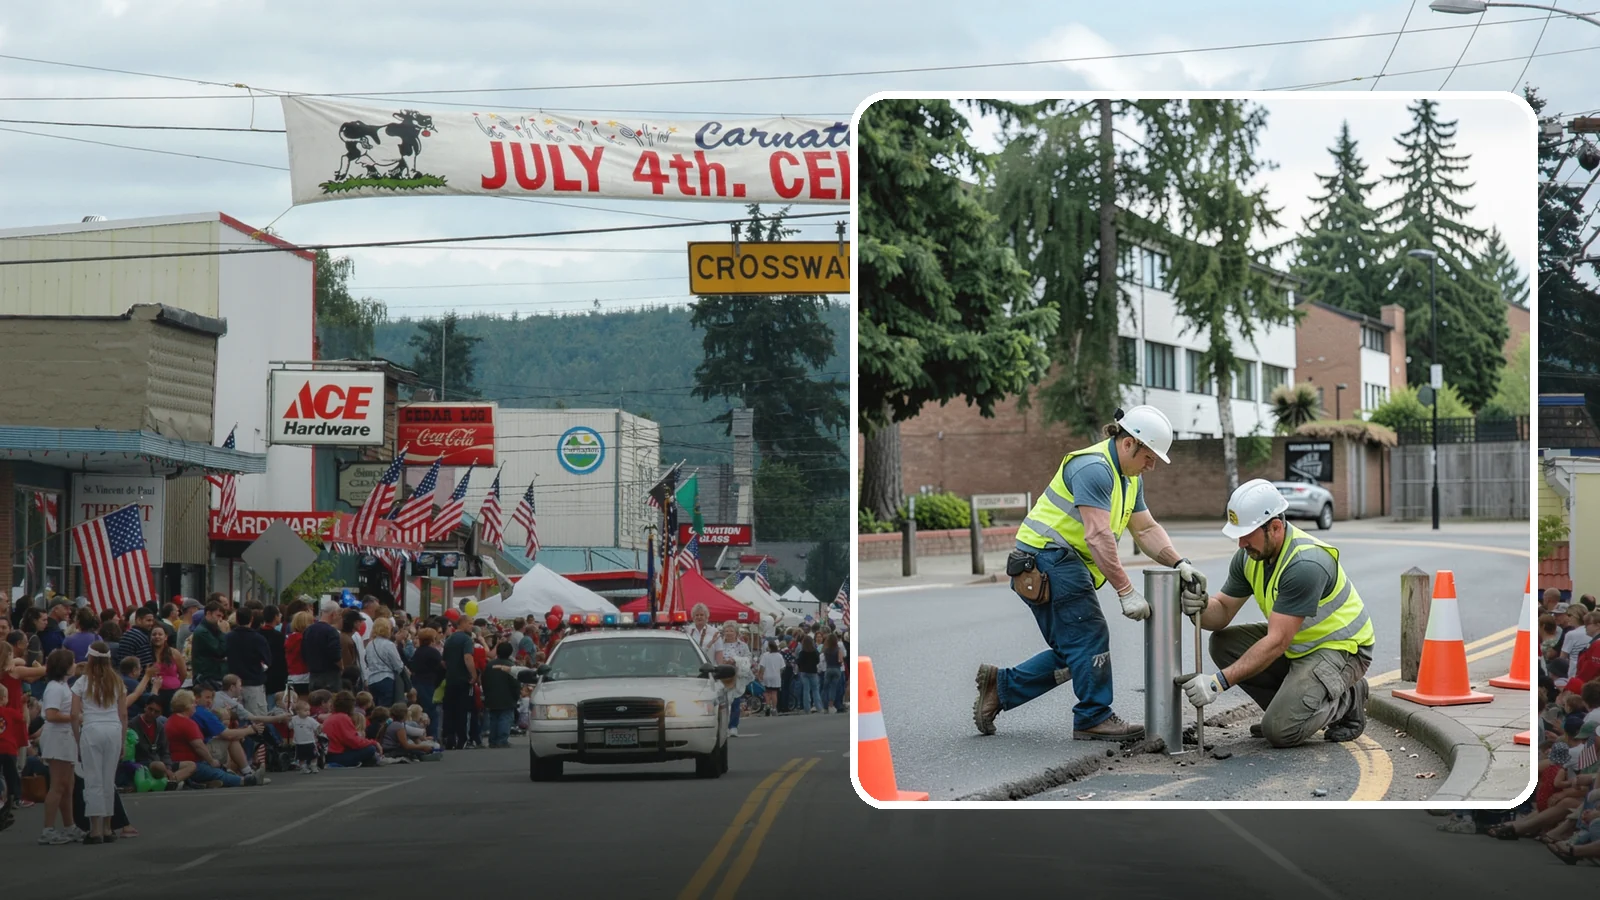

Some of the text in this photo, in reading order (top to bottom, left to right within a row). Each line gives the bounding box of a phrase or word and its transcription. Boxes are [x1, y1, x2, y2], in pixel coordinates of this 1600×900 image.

[481, 141, 604, 192] JULY
[632, 150, 746, 197] 4th.
[696, 254, 850, 279] CROSSWA
[282, 379, 374, 420] ACE
[405, 409, 485, 421] CEDAR LOG
[283, 421, 371, 436] Hardware
[416, 427, 478, 447] Coca-Cola
[353, 467, 384, 480] Simpl
[95, 485, 123, 495] Vincent
[126, 485, 136, 495] de
[138, 486, 155, 496] Paul
[688, 527, 742, 535] CRNATION
[699, 535, 730, 543] GLASS
